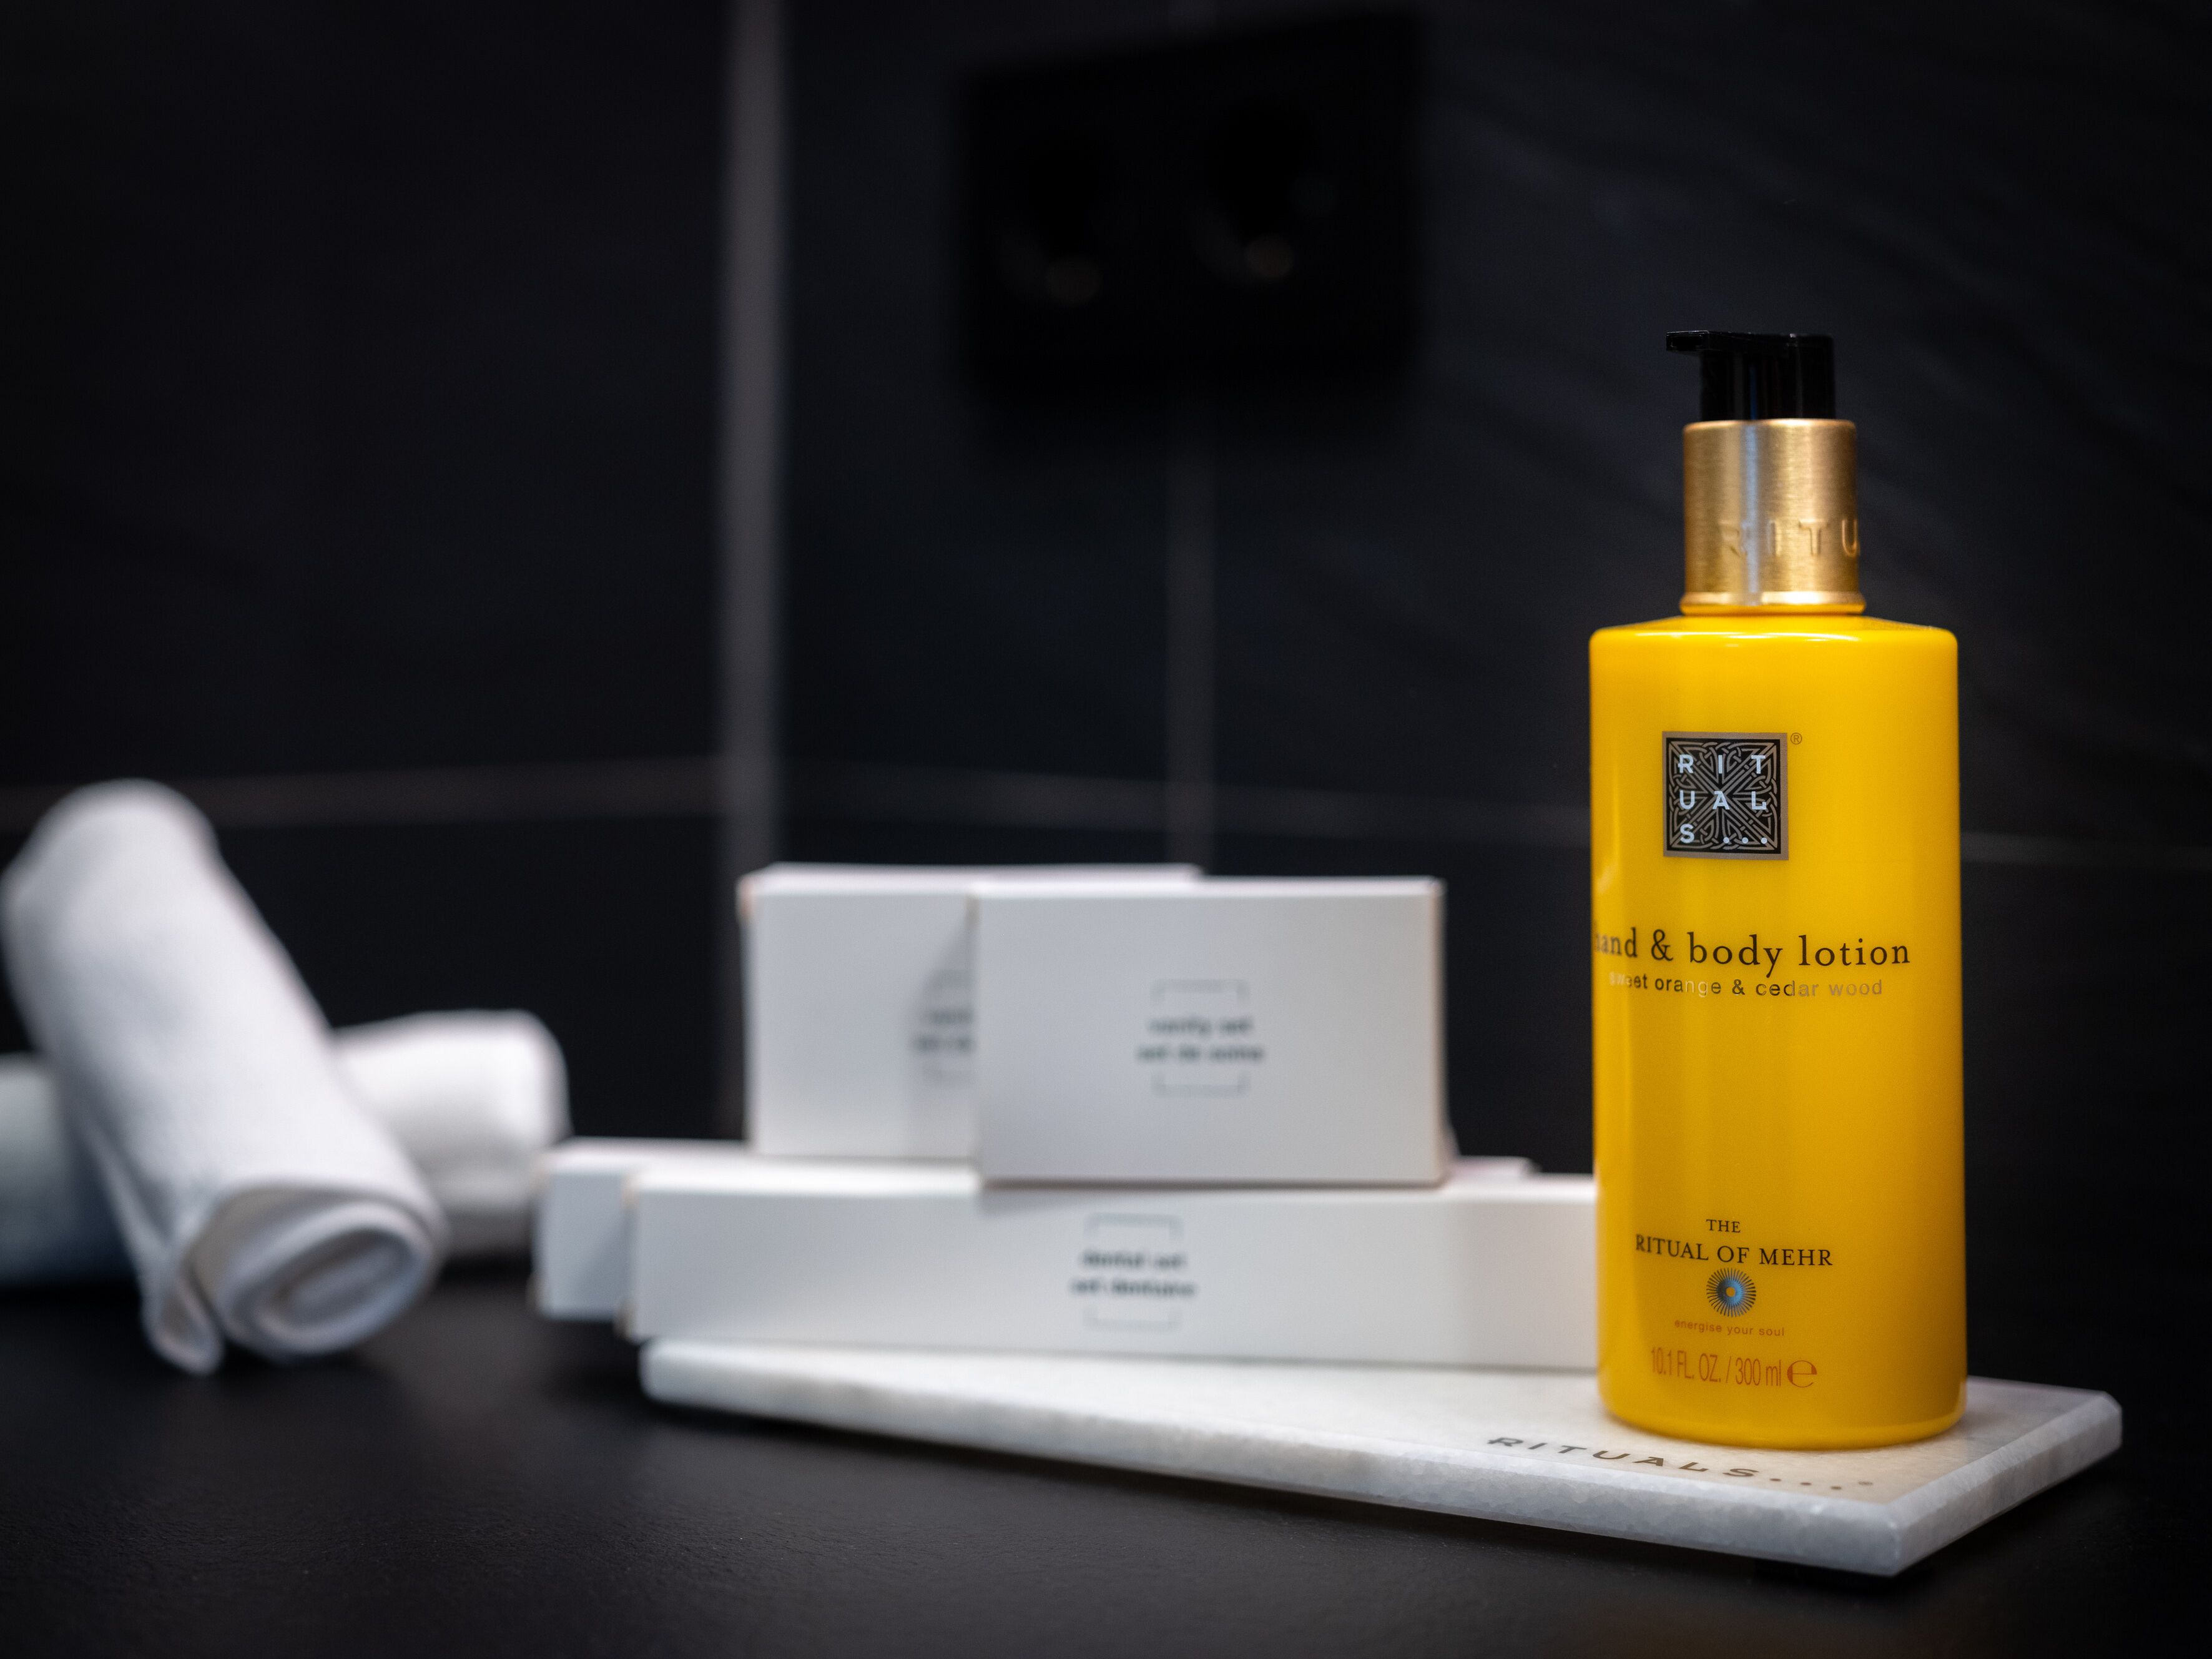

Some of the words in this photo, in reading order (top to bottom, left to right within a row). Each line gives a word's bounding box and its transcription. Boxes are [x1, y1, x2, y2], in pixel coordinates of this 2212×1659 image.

[1651, 928, 1674, 962] &
[1686, 931, 1783, 978] body
[1799, 935, 1911, 967] lotion
[1609, 972, 1648, 990] sweet
[1654, 978, 1722, 998] orange
[1732, 979, 1746, 995] &
[1755, 980, 1820, 997] cedar
[1828, 980, 1883, 996] wood
[1706, 1219, 1741, 1233] THE
[1635, 1233, 1709, 1261] RITUAL
[1717, 1245, 1750, 1264] OF
[1759, 1248, 1834, 1266] MEHR
[1674, 1319, 1723, 1333] energise
[1727, 1326, 1754, 1336] your
[1759, 1327, 1785, 1336] soul
[1651, 1346, 1673, 1376] 10.1
[1677, 1350, 1694, 1379] FL.
[1699, 1352, 1722, 1382] OZ.
[1736, 1357, 1761, 1386] 300
[1766, 1359, 1782, 1386] ml
